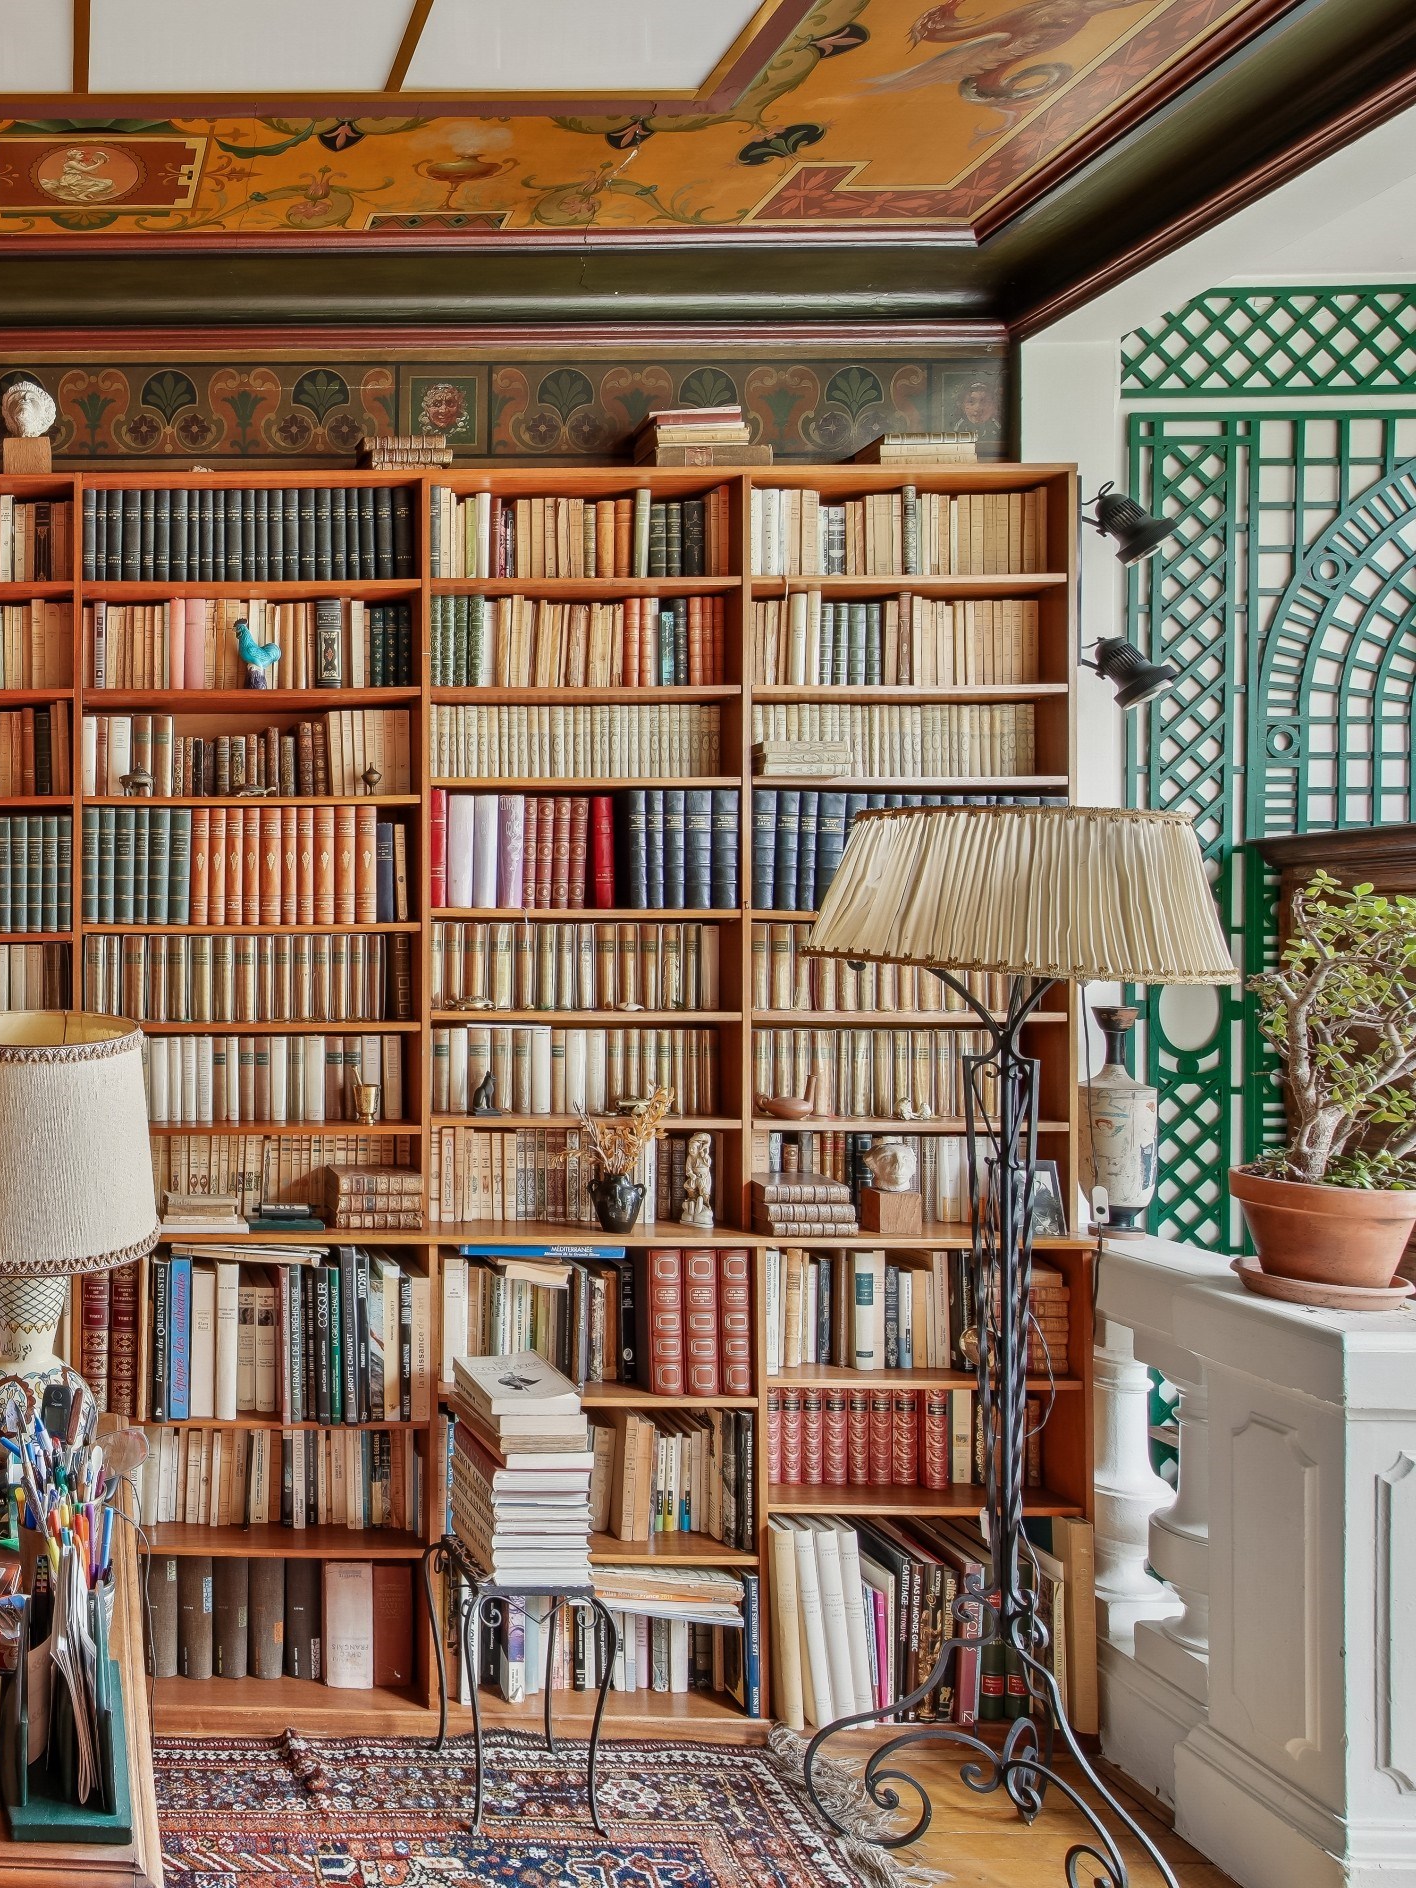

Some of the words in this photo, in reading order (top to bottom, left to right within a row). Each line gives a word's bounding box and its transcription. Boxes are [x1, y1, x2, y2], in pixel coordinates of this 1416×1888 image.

[550, 1245, 593, 1253] MÉDITERRANÉE
[358, 1268, 366, 1298] LASCAUX
[157, 1267, 165, 1335] ORIENTALISTES
[173, 1273, 185, 1333] cathédrales
[401, 1283, 411, 1306] SAPIENS
[291, 1286, 299, 1332] PRÉHISTOIRE
[318, 1282, 328, 1328] COSQUER
[416, 1296, 424, 1316] l'art
[401, 1307, 412, 1324] HOMO
[417, 1317, 424, 1329] de
[173, 1337, 184, 1353] des
[292, 1333, 299, 1342] LA
[332, 1339, 338, 1347] LA
[292, 1344, 299, 1355] DE
[417, 1332, 425, 1378] naissance
[173, 1358, 186, 1404] L'épopée
[292, 1357, 300, 1387] FRANCE
[293, 1388, 300, 1398] LA
[417, 1379, 425, 1389] la
[349, 1393, 355, 1403] LA
[901, 1564, 910, 1605] CARTHAGE
[946, 1579, 957, 1600] cités
[752, 1601, 758, 1610] DU
